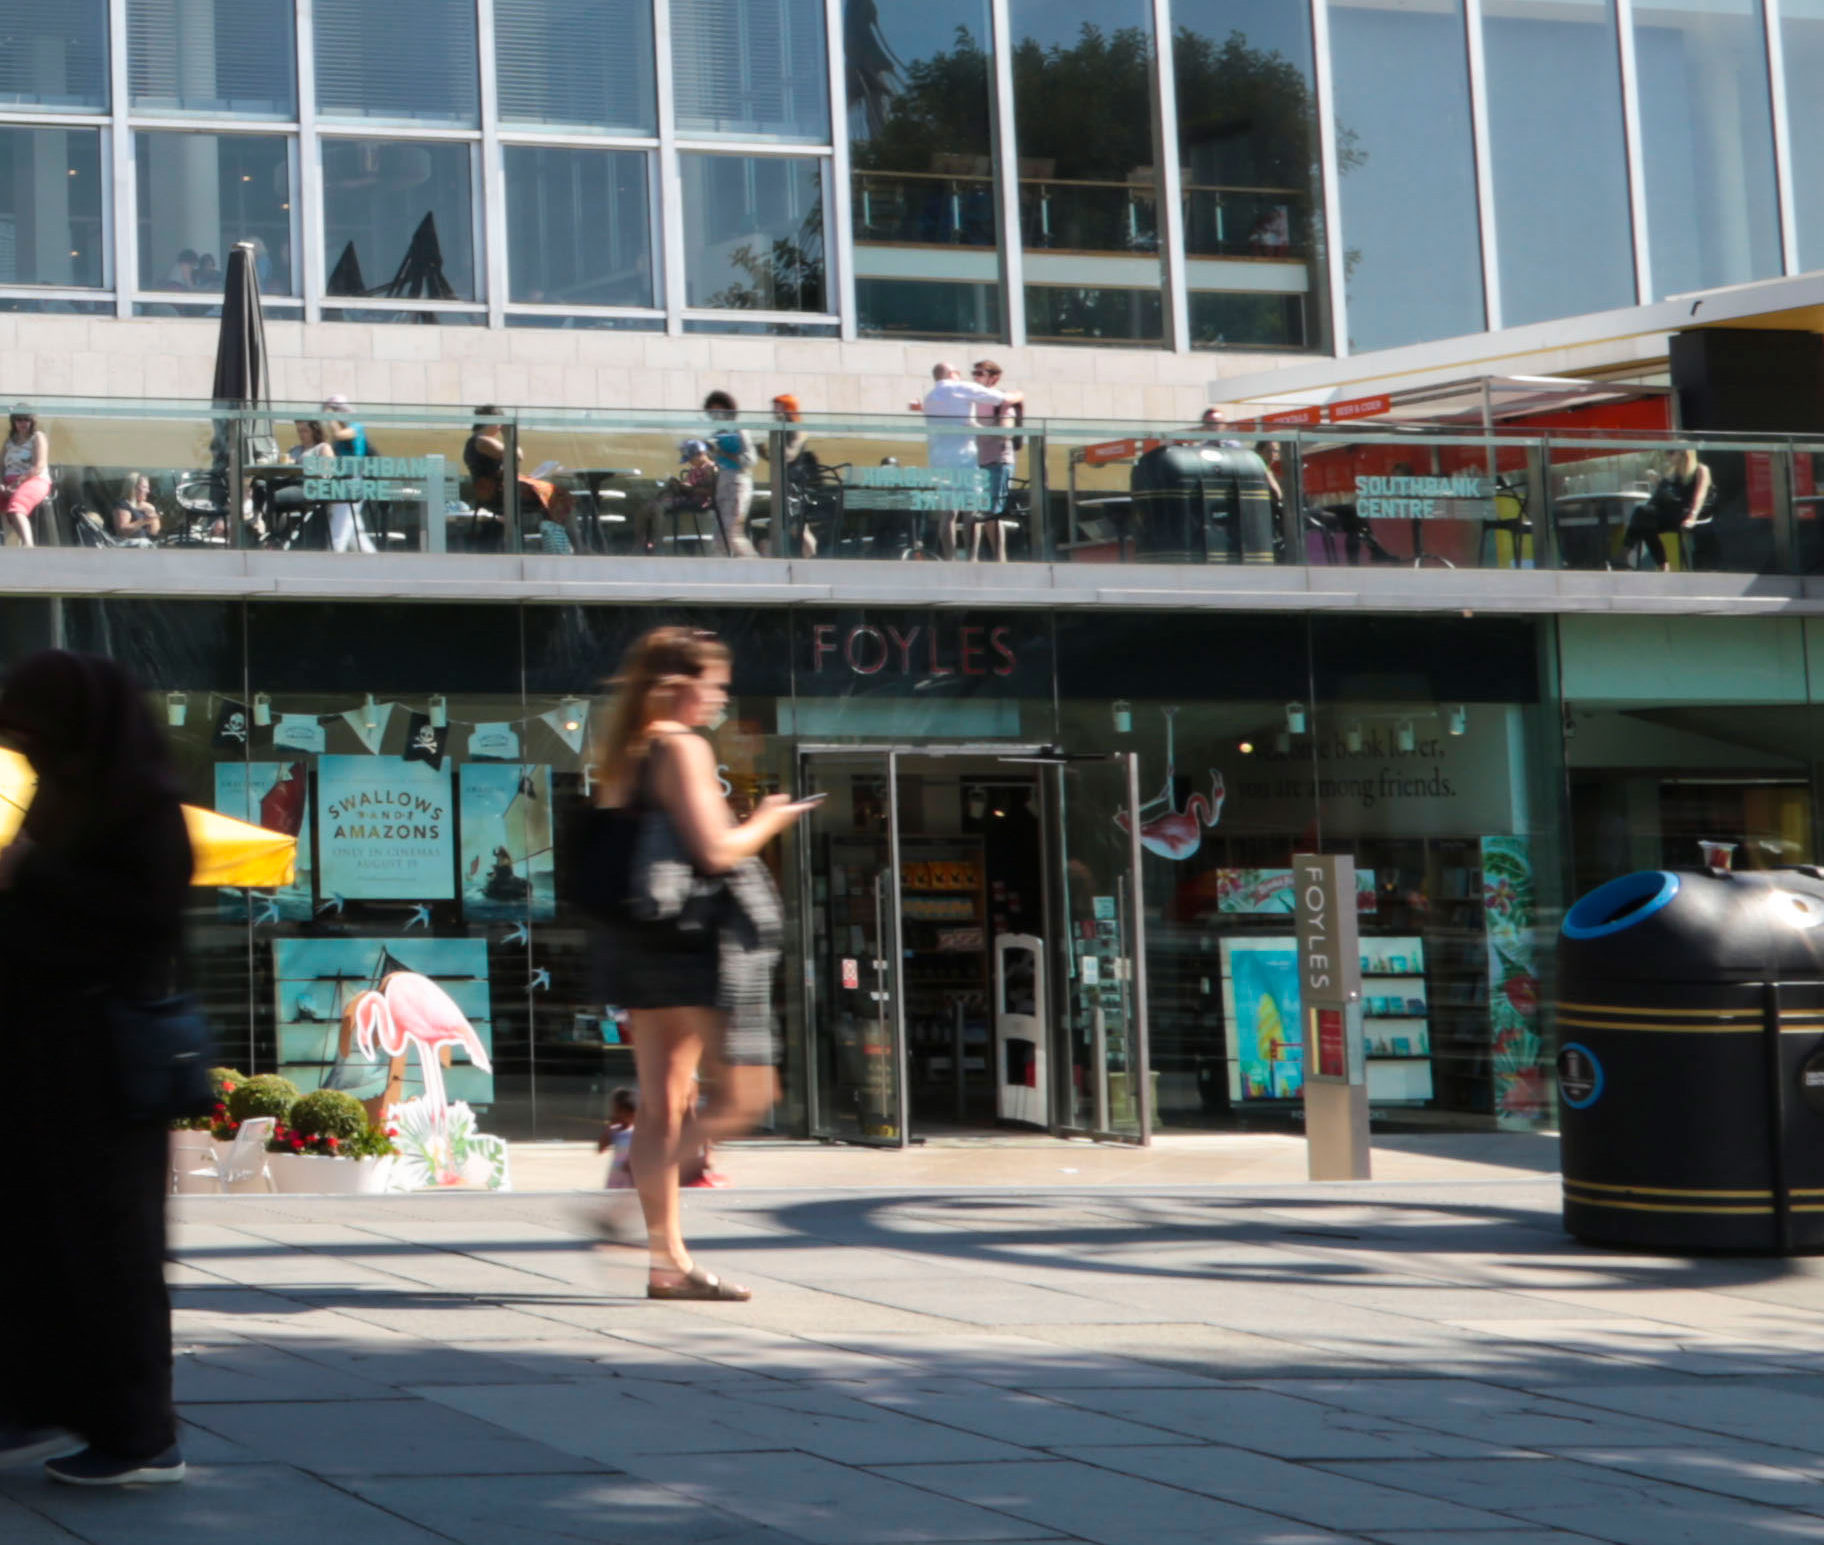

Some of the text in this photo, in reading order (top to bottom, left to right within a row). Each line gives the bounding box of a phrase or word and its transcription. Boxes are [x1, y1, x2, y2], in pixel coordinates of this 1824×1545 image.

[304, 479, 390, 500] CENTRE
[1355, 476, 1480, 497] SOUTHBANK
[1356, 498, 1436, 518] CENTRE
[813, 624, 1017, 675] FOYLES
[1379, 767, 1457, 798] friends.
[328, 790, 443, 821] SWALLOWS
[334, 824, 440, 840] AMAZONS
[1305, 867, 1330, 989] FOYLES
